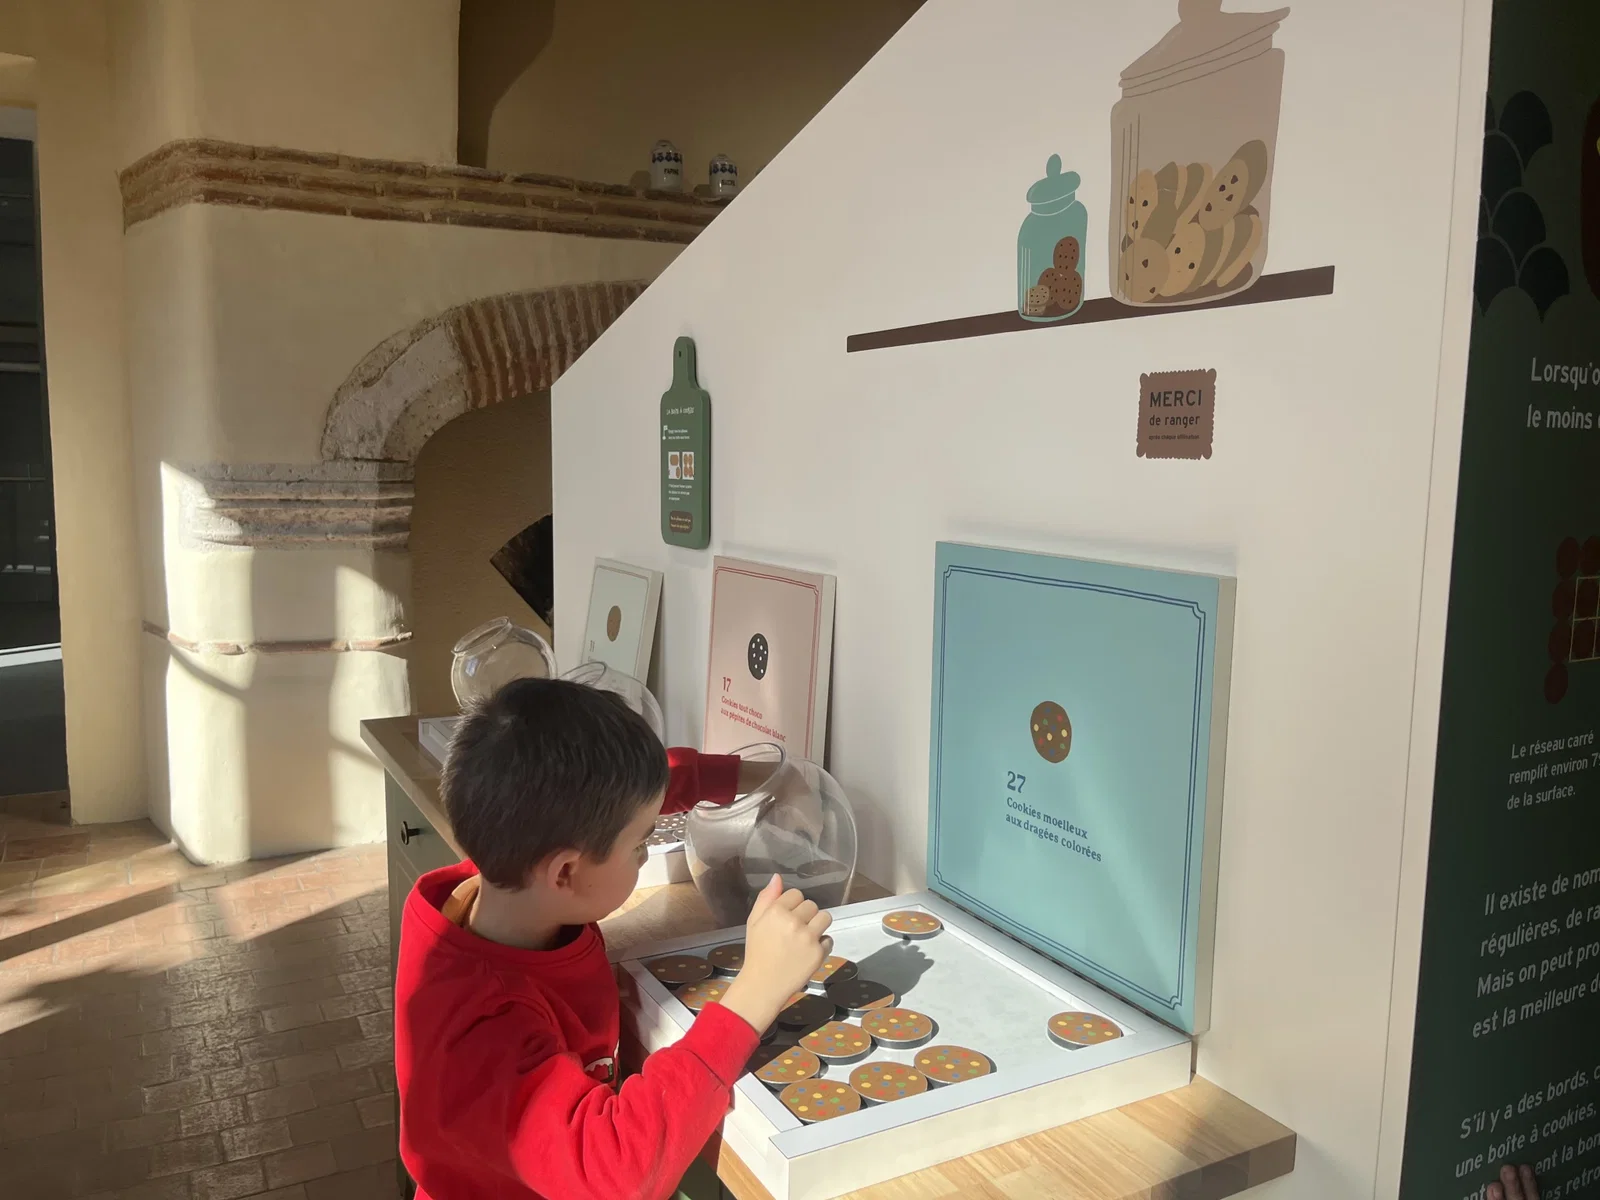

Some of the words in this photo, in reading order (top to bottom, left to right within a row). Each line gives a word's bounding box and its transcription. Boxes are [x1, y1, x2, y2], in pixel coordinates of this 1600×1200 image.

[1149, 389, 1202, 408] MERCI
[1149, 414, 1161, 426] de
[1164, 415, 1200, 429] ranger
[1526, 403, 1542, 428] le
[1546, 405, 1593, 429] moins
[722, 676, 731, 692] 17
[721, 695, 738, 710] Cookies
[738, 703, 748, 713] tout
[749, 707, 763, 720] choco
[720, 707, 729, 717] aux
[729, 711, 746, 724] pépites
[745, 718, 752, 727] de
[751, 721, 772, 736] chocolat
[772, 729, 787, 742] blanc
[1511, 743, 1527, 759] Le
[1529, 738, 1565, 756] réseau
[1567, 729, 1594, 749] carré
[1006, 770, 1026, 794] 27
[1508, 763, 1549, 785] remplit
[1550, 757, 1588, 777] environ
[1591, 752, 1600, 768] 7
[1506, 794, 1520, 811] de
[1523, 791, 1533, 807] la
[1535, 784, 1576, 804] surface.
[1006, 796, 1041, 820] Cookies
[1043, 813, 1088, 840] moelleux
[1005, 813, 1022, 829] aux
[1023, 820, 1059, 844] dragées
[1061, 837, 1102, 862] colorées
[1484, 892, 1496, 916] Il
[1499, 880, 1548, 911] existe
[1551, 873, 1569, 896] de
[1480, 918, 1561, 957] régulières,
[1566, 907, 1582, 929] de
[1476, 968, 1514, 998] Mais
[1518, 963, 1536, 983] on
[1539, 945, 1573, 982] peut
[1576, 941, 1600, 969] pro
[1472, 1010, 1499, 1039] est
[1502, 1006, 1516, 1028] la
[1519, 982, 1586, 1021] meilleure
[1590, 972, 1600, 993] d
[1460, 1110, 1486, 1139] S'il
[1490, 1108, 1500, 1133] y
[1503, 1103, 1513, 1120] a
[1517, 1089, 1543, 1114] des
[1455, 1152, 1483, 1178] une
[1487, 1132, 1526, 1164] boîte
[1529, 1123, 1539, 1144] à
[1542, 1101, 1597, 1138] cookies,
[1561, 1144, 1573, 1163] la
